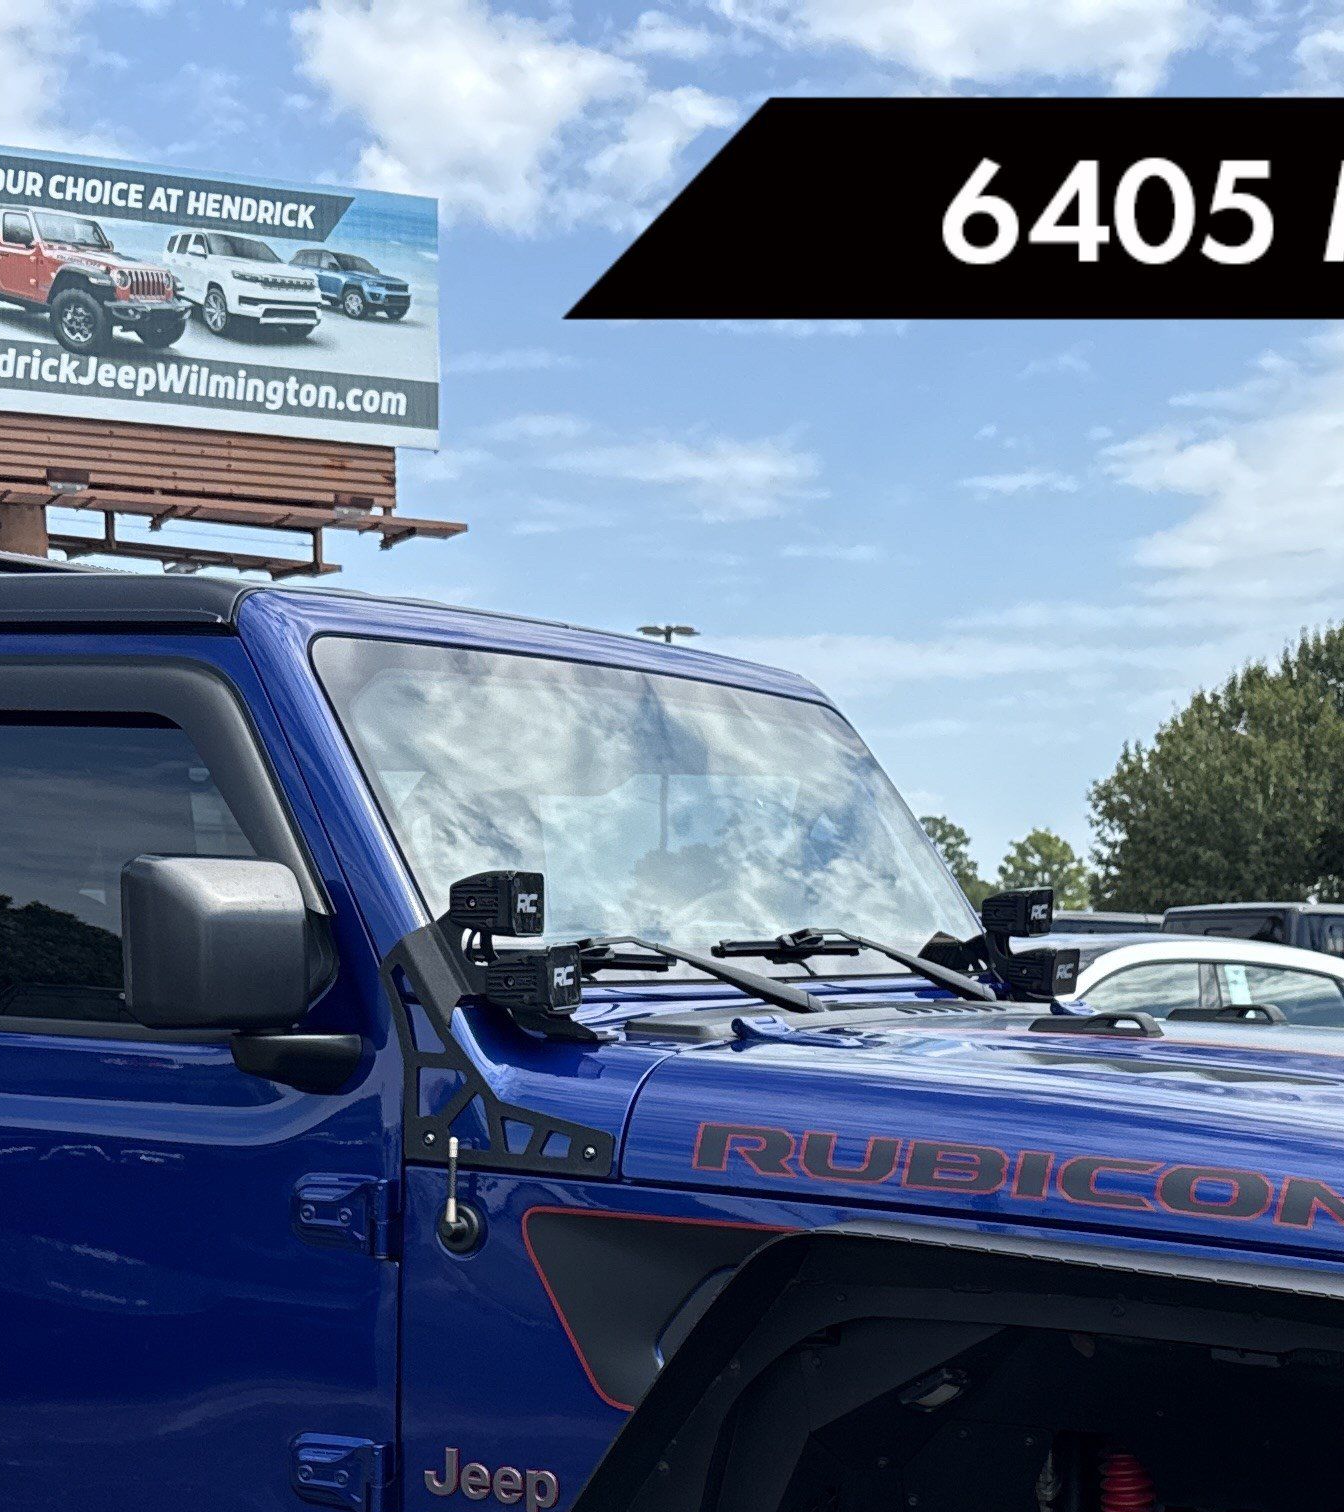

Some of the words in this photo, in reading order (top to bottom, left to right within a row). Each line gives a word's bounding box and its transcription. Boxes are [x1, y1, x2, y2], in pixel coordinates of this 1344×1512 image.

[48, 174, 144, 209] CHOICE
[148, 189, 184, 214] AT
[187, 190, 317, 230] HENDRICK
[517, 893, 538, 914] RC
[1030, 903, 1049, 921] RC
[553, 965, 575, 988] RC
[1056, 962, 1075, 980] RC
